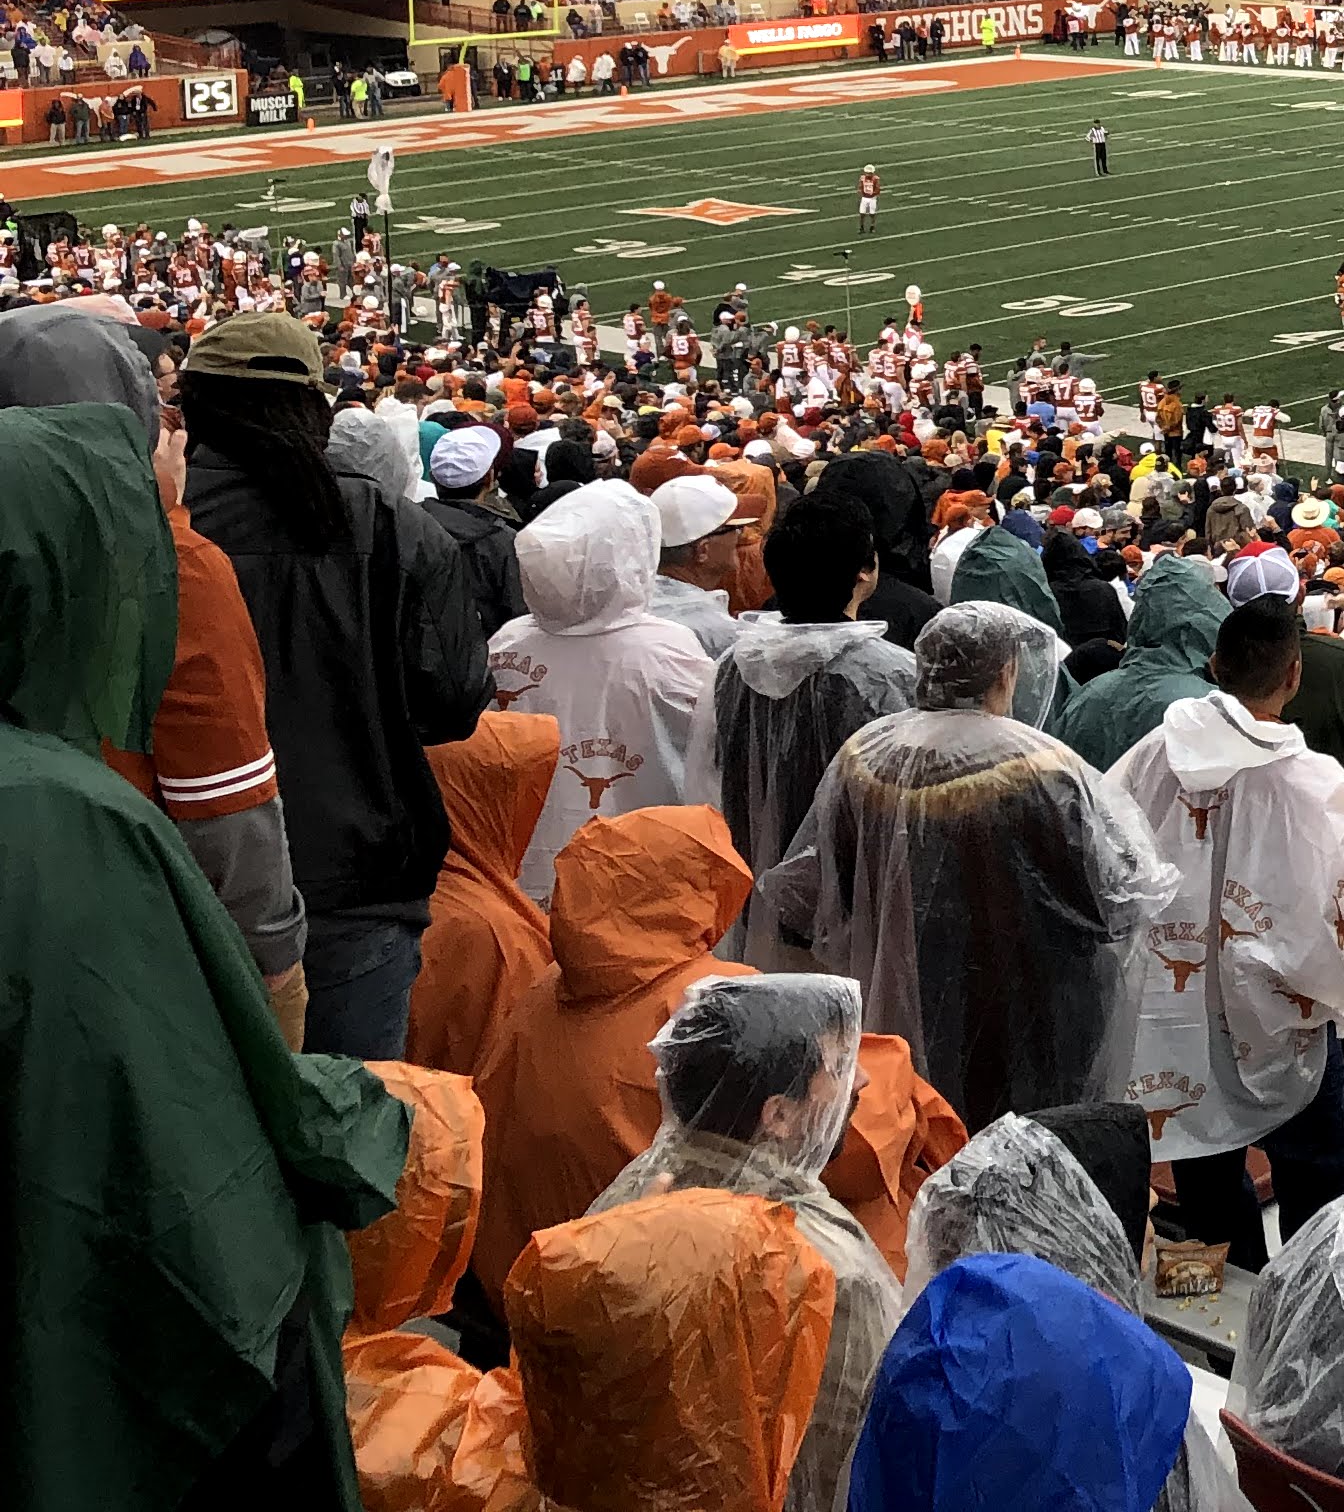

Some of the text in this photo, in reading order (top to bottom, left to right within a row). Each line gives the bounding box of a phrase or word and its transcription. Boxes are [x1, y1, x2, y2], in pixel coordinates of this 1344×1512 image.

[747, 22, 843, 44] WELLS FARGO
[192, 80, 231, 113] 25
[250, 94, 295, 112] MUSCLE
[259, 107, 287, 124] MILK
[1001, 294, 1134, 317] 50
[490, 651, 548, 683] EXAS
[560, 737, 644, 772] TEXAS
[1224, 878, 1272, 934] EXAS
[1150, 921, 1208, 947] TEXA
[1125, 1070, 1207, 1101] TEXAS
